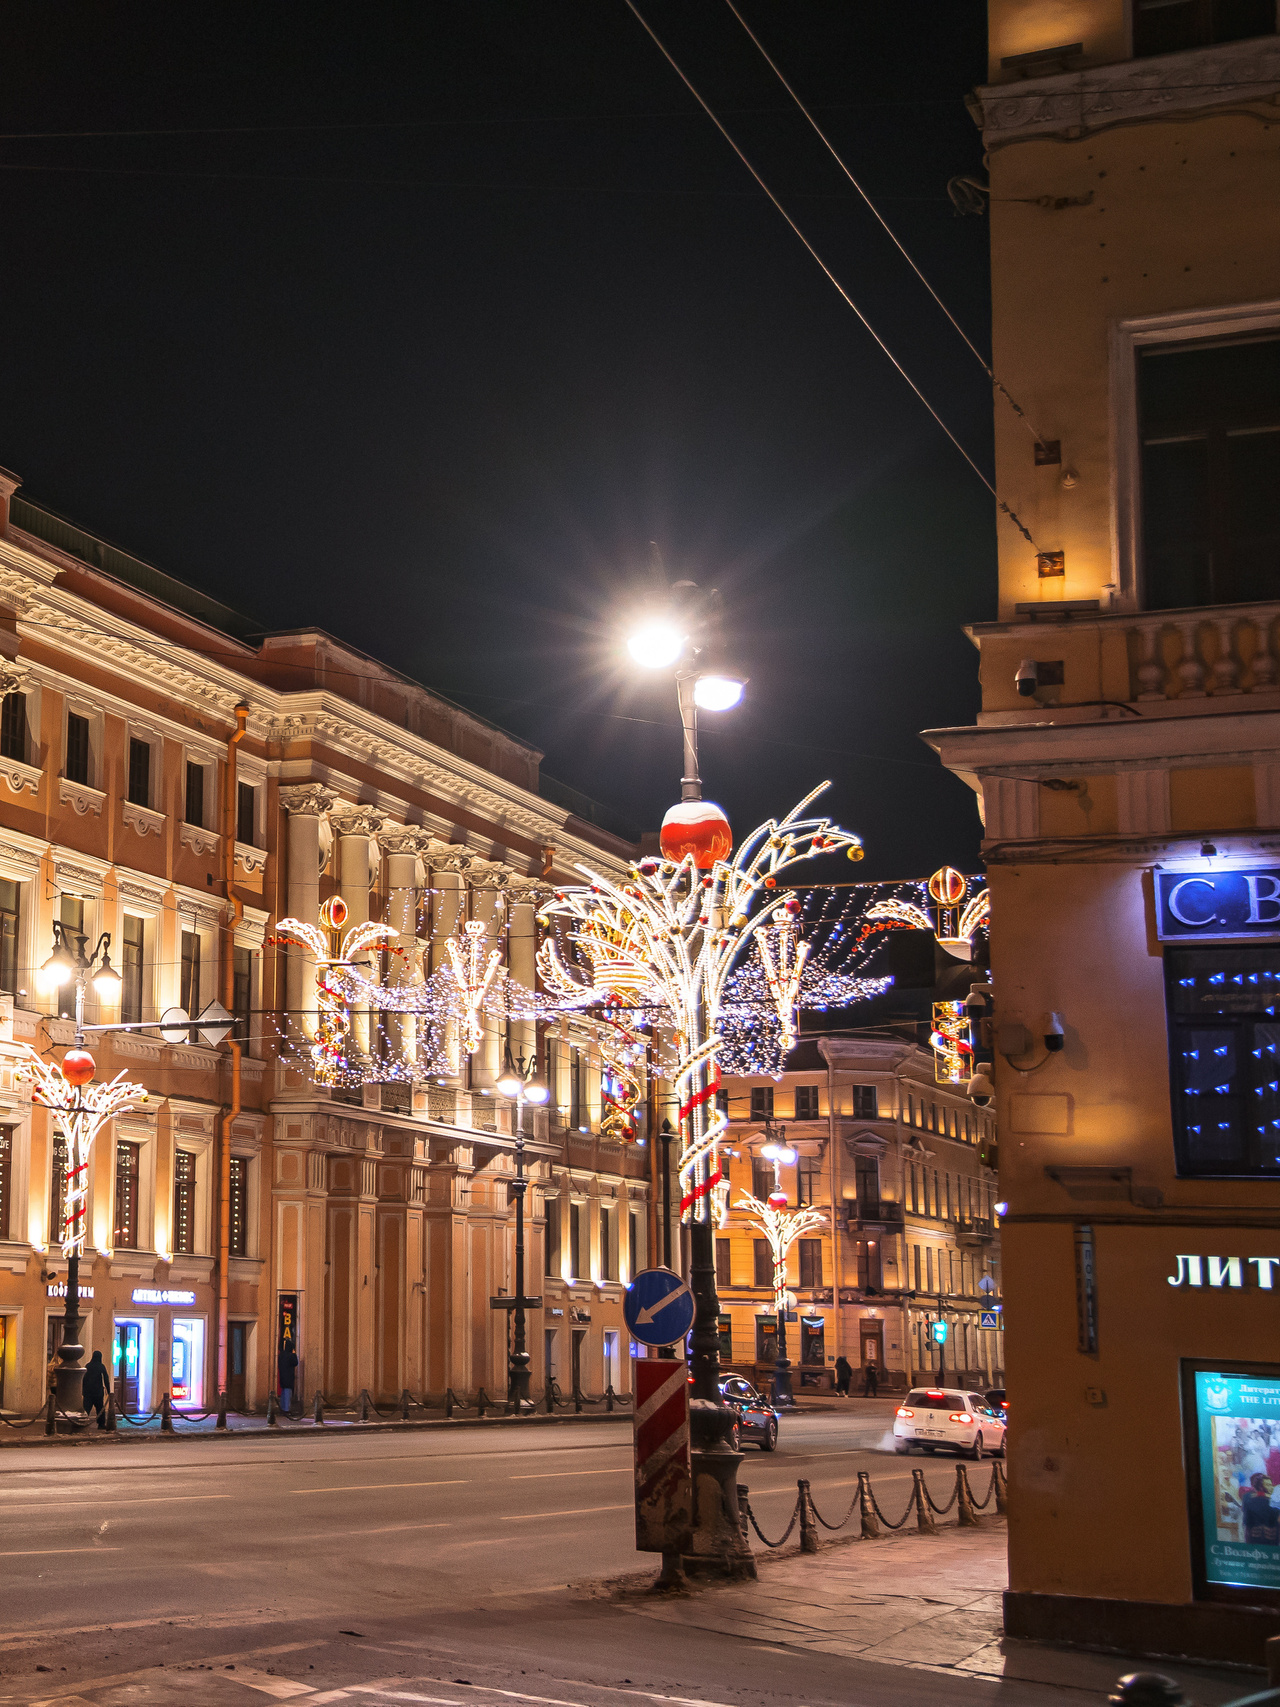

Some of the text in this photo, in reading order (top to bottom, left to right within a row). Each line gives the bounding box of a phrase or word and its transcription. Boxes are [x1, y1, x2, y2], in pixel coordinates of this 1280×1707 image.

[1167, 1254, 1280, 1290] ЛИТ
[1239, 1395, 1280, 1405] THE LIT
